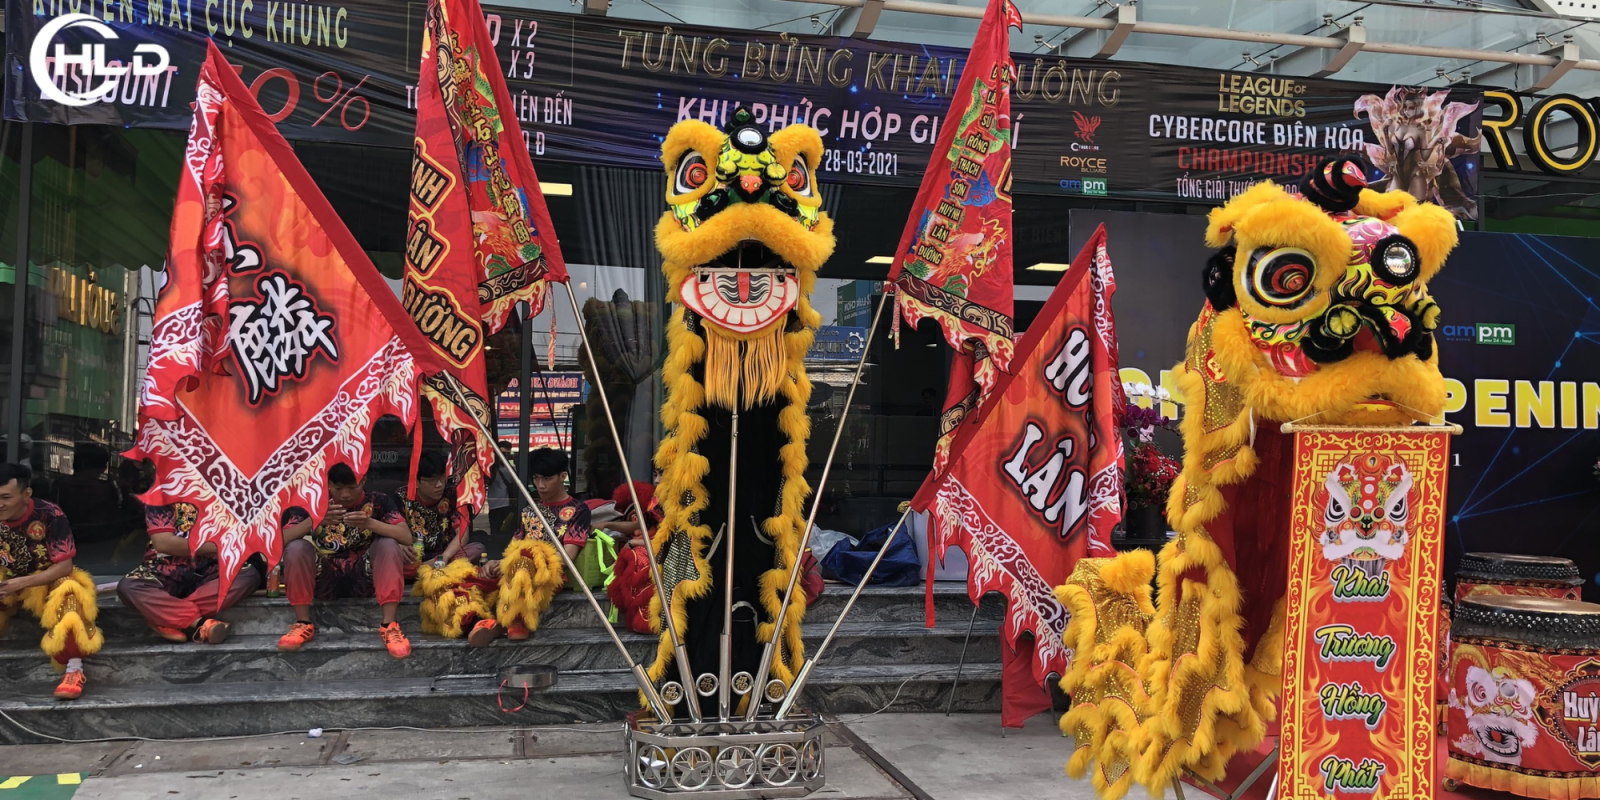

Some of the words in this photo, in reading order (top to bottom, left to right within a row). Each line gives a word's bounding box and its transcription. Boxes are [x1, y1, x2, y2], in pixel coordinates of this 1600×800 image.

[864, 51, 957, 95] KHAI
[1015, 57, 1122, 108] ƯƠNG
[1219, 74, 1294, 97] LEAGUE
[1294, 85, 1306, 95] OF
[544, 90, 572, 125] ĐẾN
[1218, 94, 1306, 117] LEGENDS
[840, 108, 901, 152] HỢP
[1150, 114, 1266, 144] CYBERCORE
[1274, 120, 1317, 147] BIÊN
[1325, 123, 1364, 150] HÒA
[1482, 90, 1600, 171] RO
[824, 149, 898, 175] 28-03-2021
[957, 158, 980, 176] THẠCH
[1060, 156, 1107, 169] ROYCE
[1178, 147, 1323, 175] CHAMPIONSH
[1177, 172, 1203, 198] TỔNG
[1205, 175, 1226, 199] GIẢI
[931, 225, 949, 242] LÂN
[1004, 423, 1089, 536] LÂN
[1331, 564, 1390, 599] Khai
[1319, 682, 1386, 726] Hồng
[1563, 691, 1600, 724] Huỳ
[1320, 756, 1384, 791] Phát
